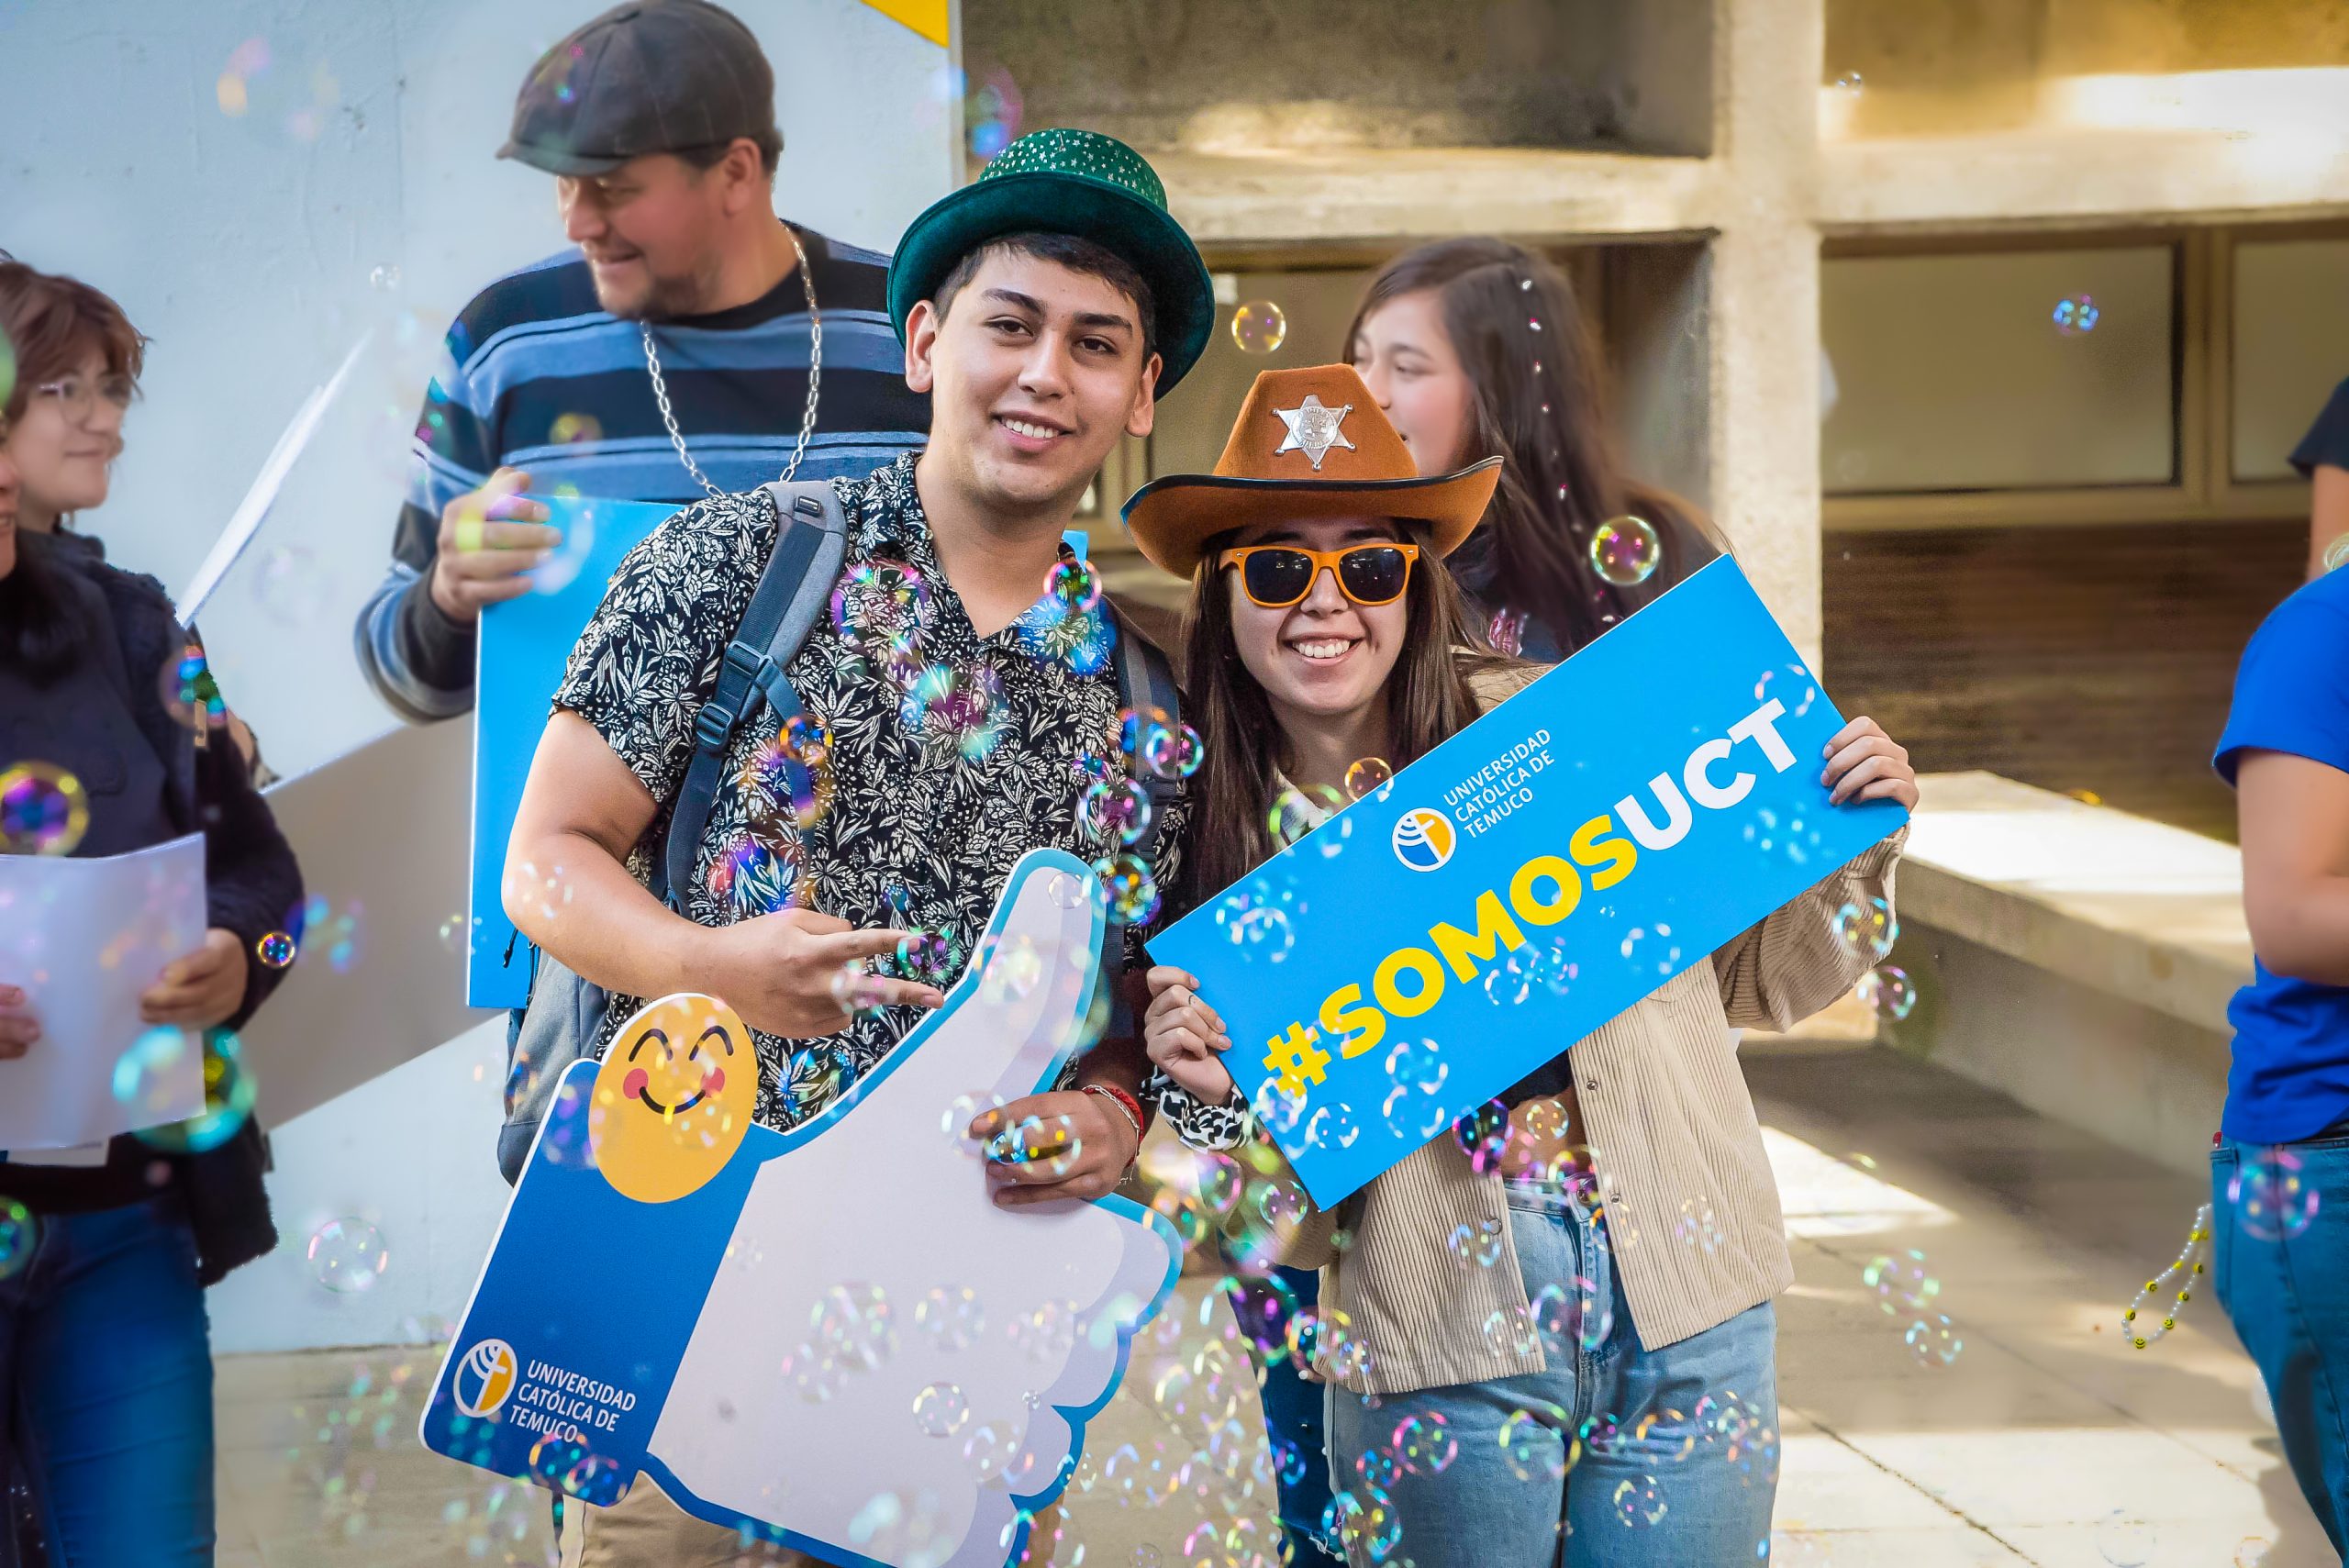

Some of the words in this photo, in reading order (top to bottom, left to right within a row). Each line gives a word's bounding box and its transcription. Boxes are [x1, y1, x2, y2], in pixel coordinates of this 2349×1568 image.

[1443, 728, 1551, 806] UNIVERSIDAD
[1455, 767, 1531, 822] CATÓLICA
[1530, 749, 1555, 773] DE
[1464, 787, 1533, 839] TEMUCO
[1262, 697, 1798, 1098] #SOMOSUCT
[518, 1383, 593, 1424] CATÓLICA
[595, 1408, 619, 1432] DE
[528, 1359, 636, 1412] UNIVERSIDAD
[509, 1405, 578, 1443] TEMUCO
